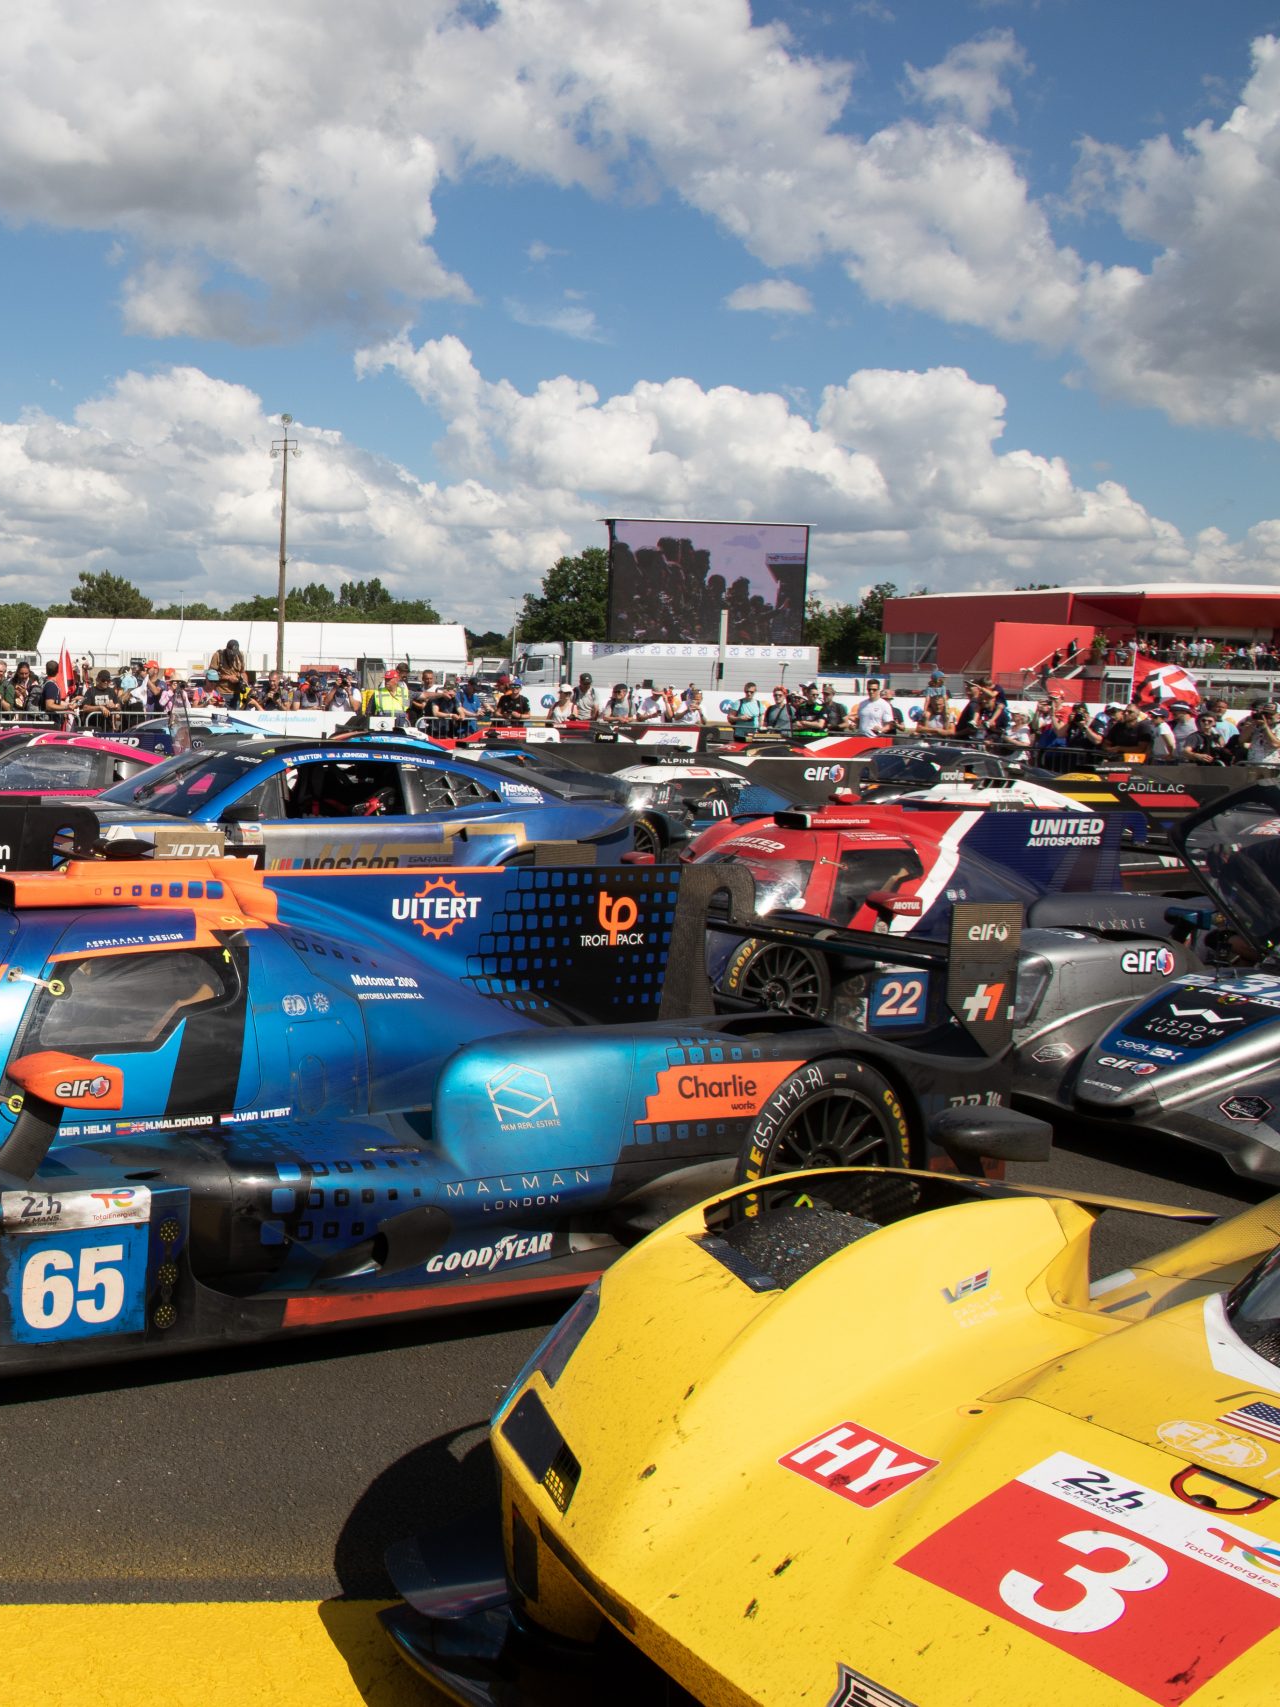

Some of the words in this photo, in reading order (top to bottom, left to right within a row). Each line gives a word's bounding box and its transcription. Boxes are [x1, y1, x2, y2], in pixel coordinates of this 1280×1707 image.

[483, 730, 546, 739] PRSCHE
[804, 766, 829, 781] elf
[1118, 783, 1185, 794] CADILLAC
[1030, 818, 1105, 836] UNITED
[159, 843, 220, 857] JOTA
[1027, 836, 1101, 847] AUTOSPORTS
[392, 896, 481, 921] UITERT
[893, 901, 920, 910] MOTUL
[616, 933, 644, 946] PACK
[968, 923, 995, 941] elf
[1122, 950, 1156, 973] elf
[350, 974, 396, 987] Motomar
[395, 976, 418, 988] 2000
[283, 998, 306, 1012] FIA
[876, 980, 923, 1017] 22
[1144, 1023, 1203, 1041] AUDIO
[1116, 1040, 1149, 1052] COOL
[1098, 1056, 1136, 1069] elf
[55, 1080, 90, 1098] elf
[678, 1074, 757, 1100] Charlie
[260, 1107, 291, 1119] UITERT
[731, 1101, 756, 1111] works
[753, 1065, 829, 1150] 65-LM-12-RL
[59, 1126, 81, 1137] DER
[83, 1124, 111, 1136] HELM
[145, 1115, 213, 1131] M.MALDONADO
[447, 1169, 591, 1197] MALMAN
[483, 1194, 560, 1212] LONDON
[93, 1211, 137, 1221] TotalEnergies
[426, 1232, 553, 1273] GOODYEAR
[21, 1244, 124, 1330] 65
[1161, 1421, 1251, 1465] FIA
[789, 1427, 930, 1494] HY
[1051, 1480, 1076, 1492] LE
[1076, 1490, 1126, 1514] MANS
[1184, 1541, 1280, 1588] TotalEnergies
[999, 1529, 1170, 1635] 3
